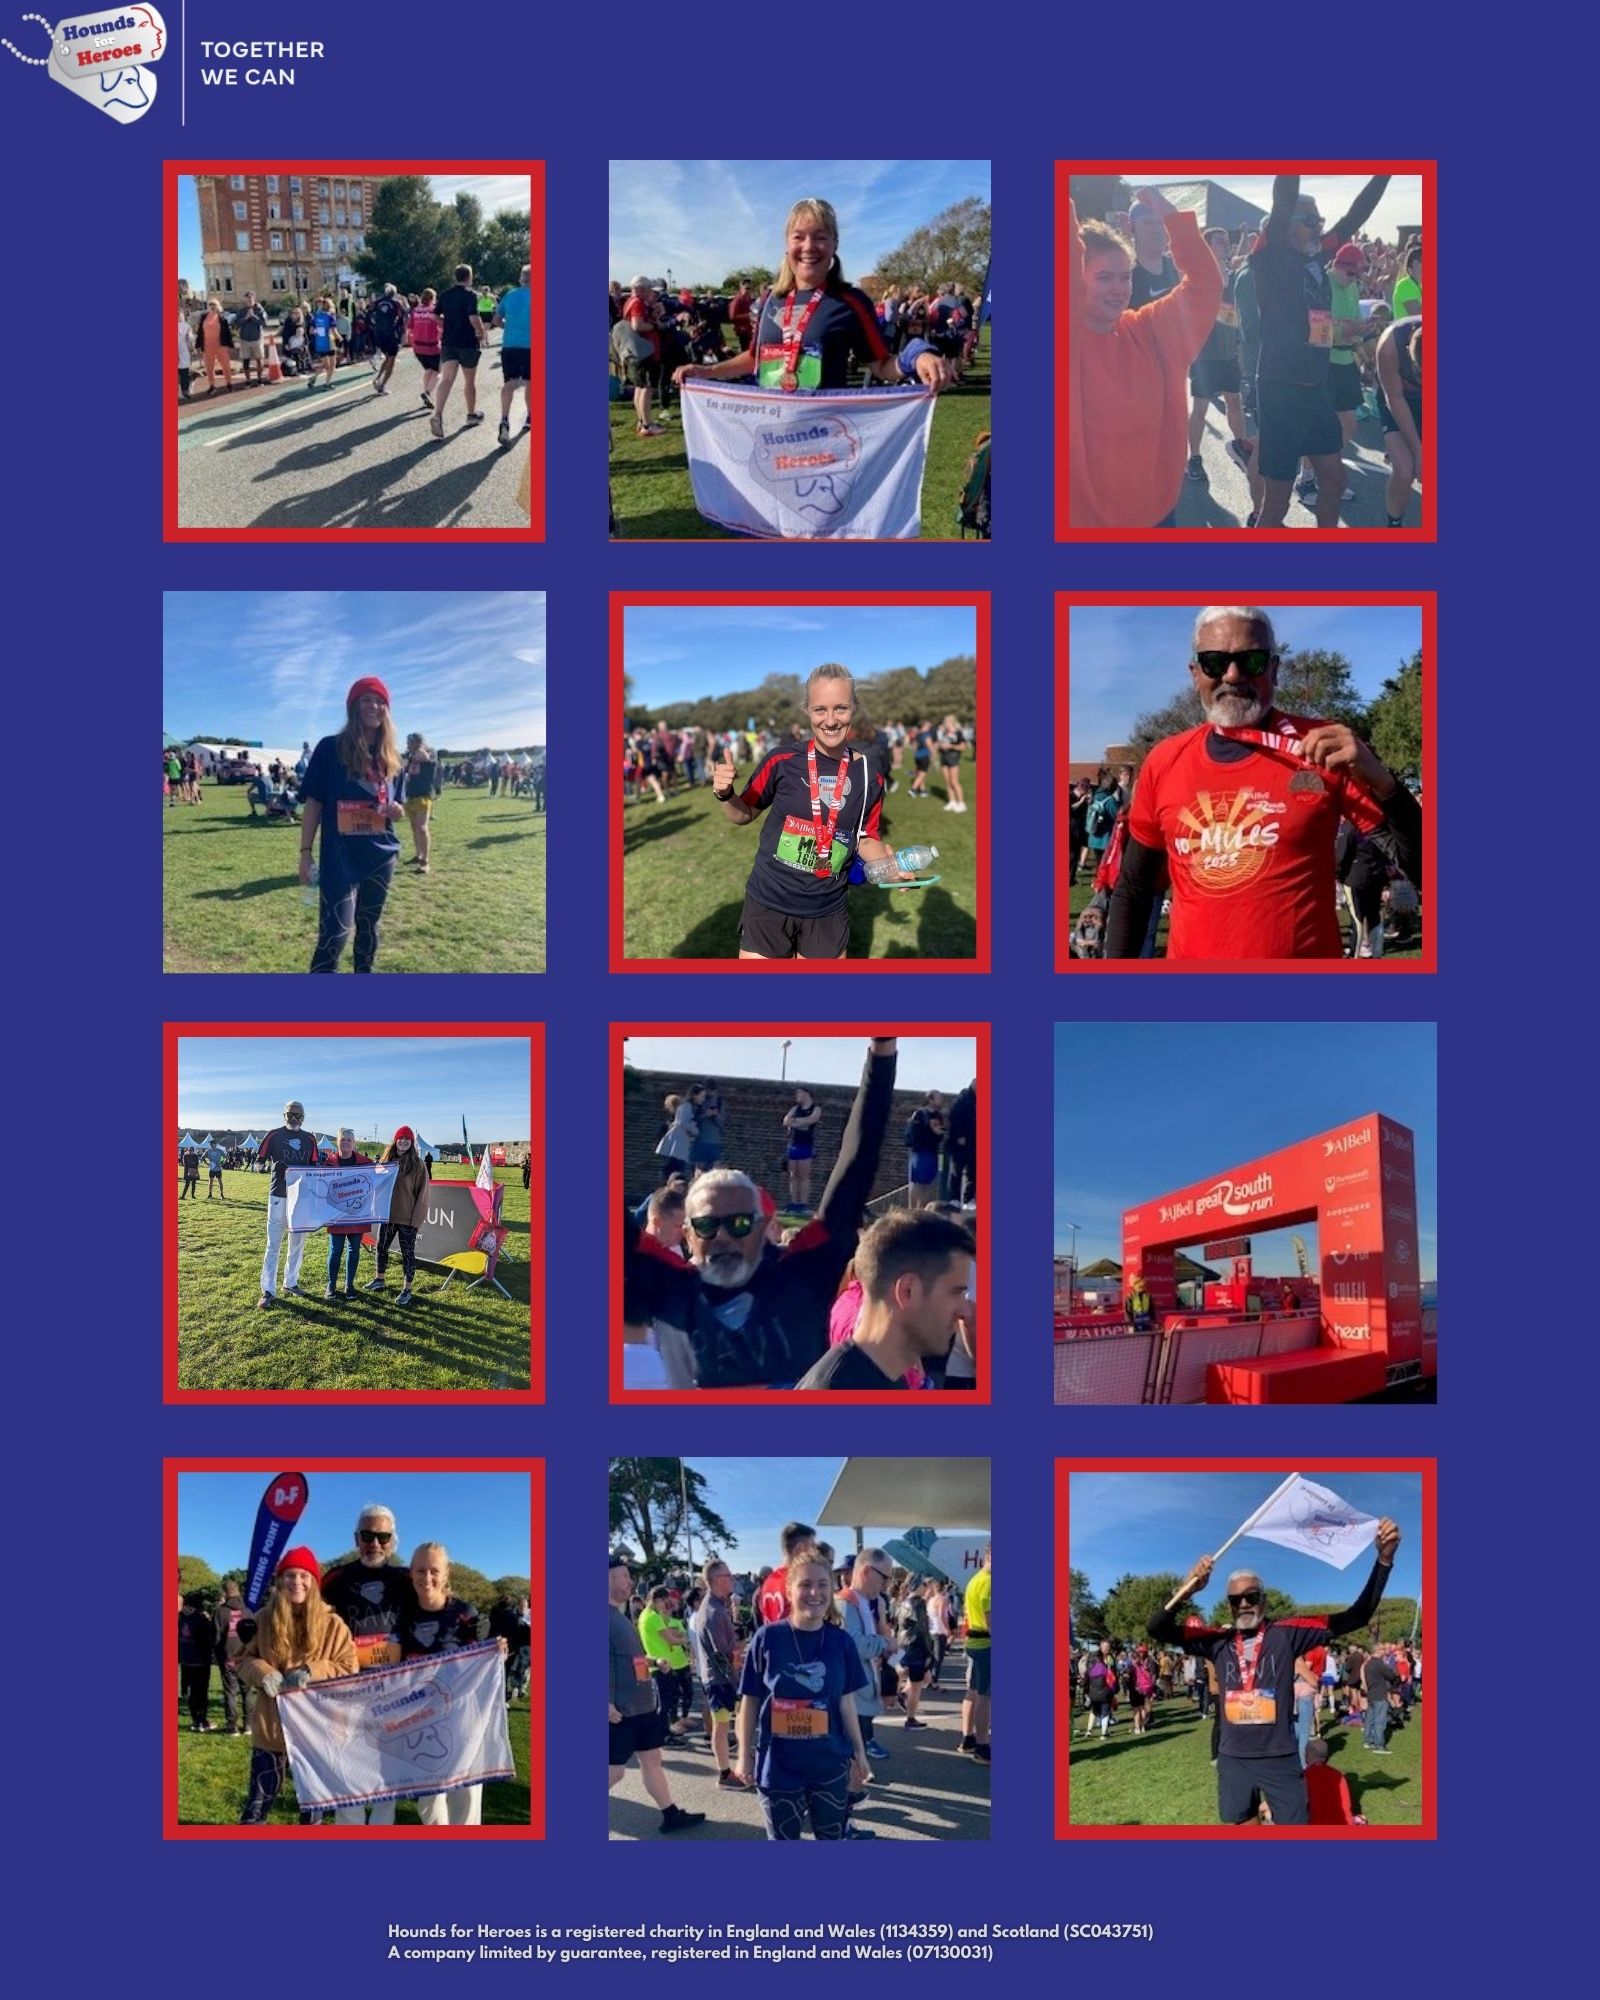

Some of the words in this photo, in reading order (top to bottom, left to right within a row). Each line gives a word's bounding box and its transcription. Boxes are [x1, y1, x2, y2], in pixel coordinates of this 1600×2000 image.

[706, 399, 719, 408] In
[722, 401, 767, 415] support
[769, 406, 782, 418] of
[762, 425, 830, 446] Hounds
[775, 451, 837, 471] Heroes
[1174, 838, 1190, 856] 10
[1333, 1128, 1371, 1154] AJBell
[332, 1178, 361, 1190] Hounds
[338, 1188, 364, 1199] Heroes
[1195, 1188, 1224, 1216] great
[1234, 1172, 1272, 1200] south
[1250, 1195, 1274, 1213] run
[423, 1207, 455, 1230] UN
[1335, 1323, 1371, 1340] heart
[274, 1486, 299, 1506] D-F
[248, 1556, 269, 1604] MEETING
[262, 1520, 281, 1555] POINT
[1225, 1654, 1276, 1683] RVI
[371, 1687, 428, 1718] Hounds
[384, 1707, 437, 1733] Heroes
